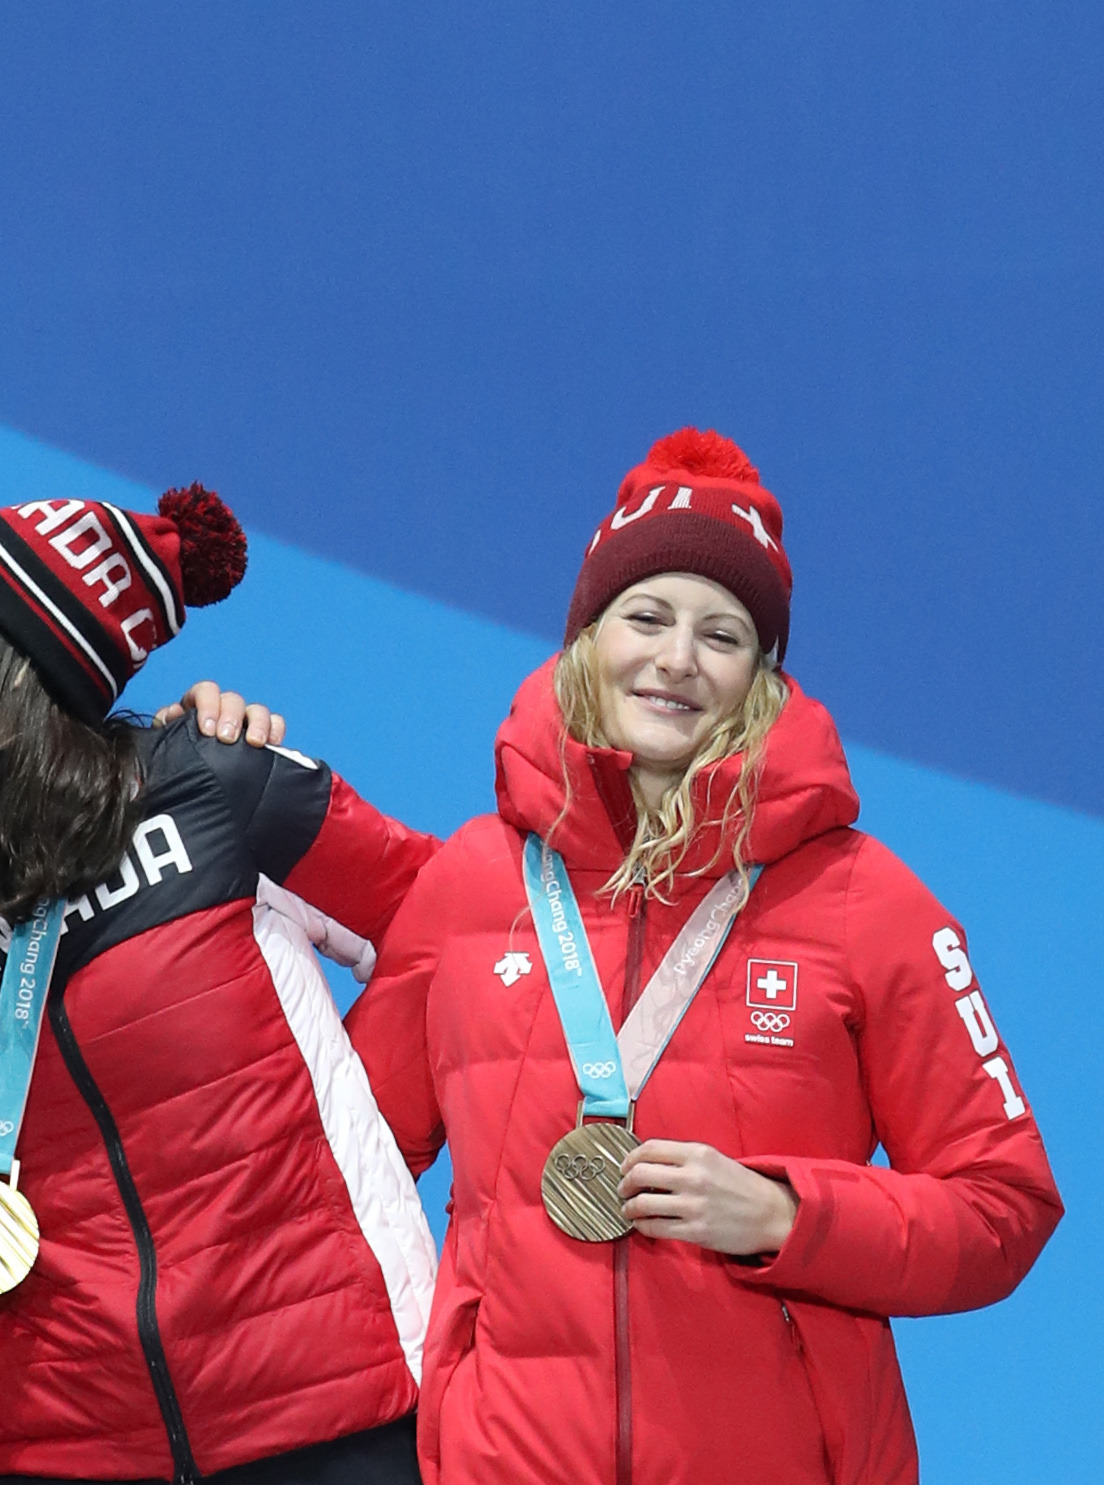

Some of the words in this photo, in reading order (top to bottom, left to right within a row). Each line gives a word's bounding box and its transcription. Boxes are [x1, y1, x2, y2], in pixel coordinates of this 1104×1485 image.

[11, 500, 132, 608] ADA
[744, 1033, 770, 1044] swiss
[771, 1036, 794, 1048] team
[932, 926, 1026, 1121] SUI
